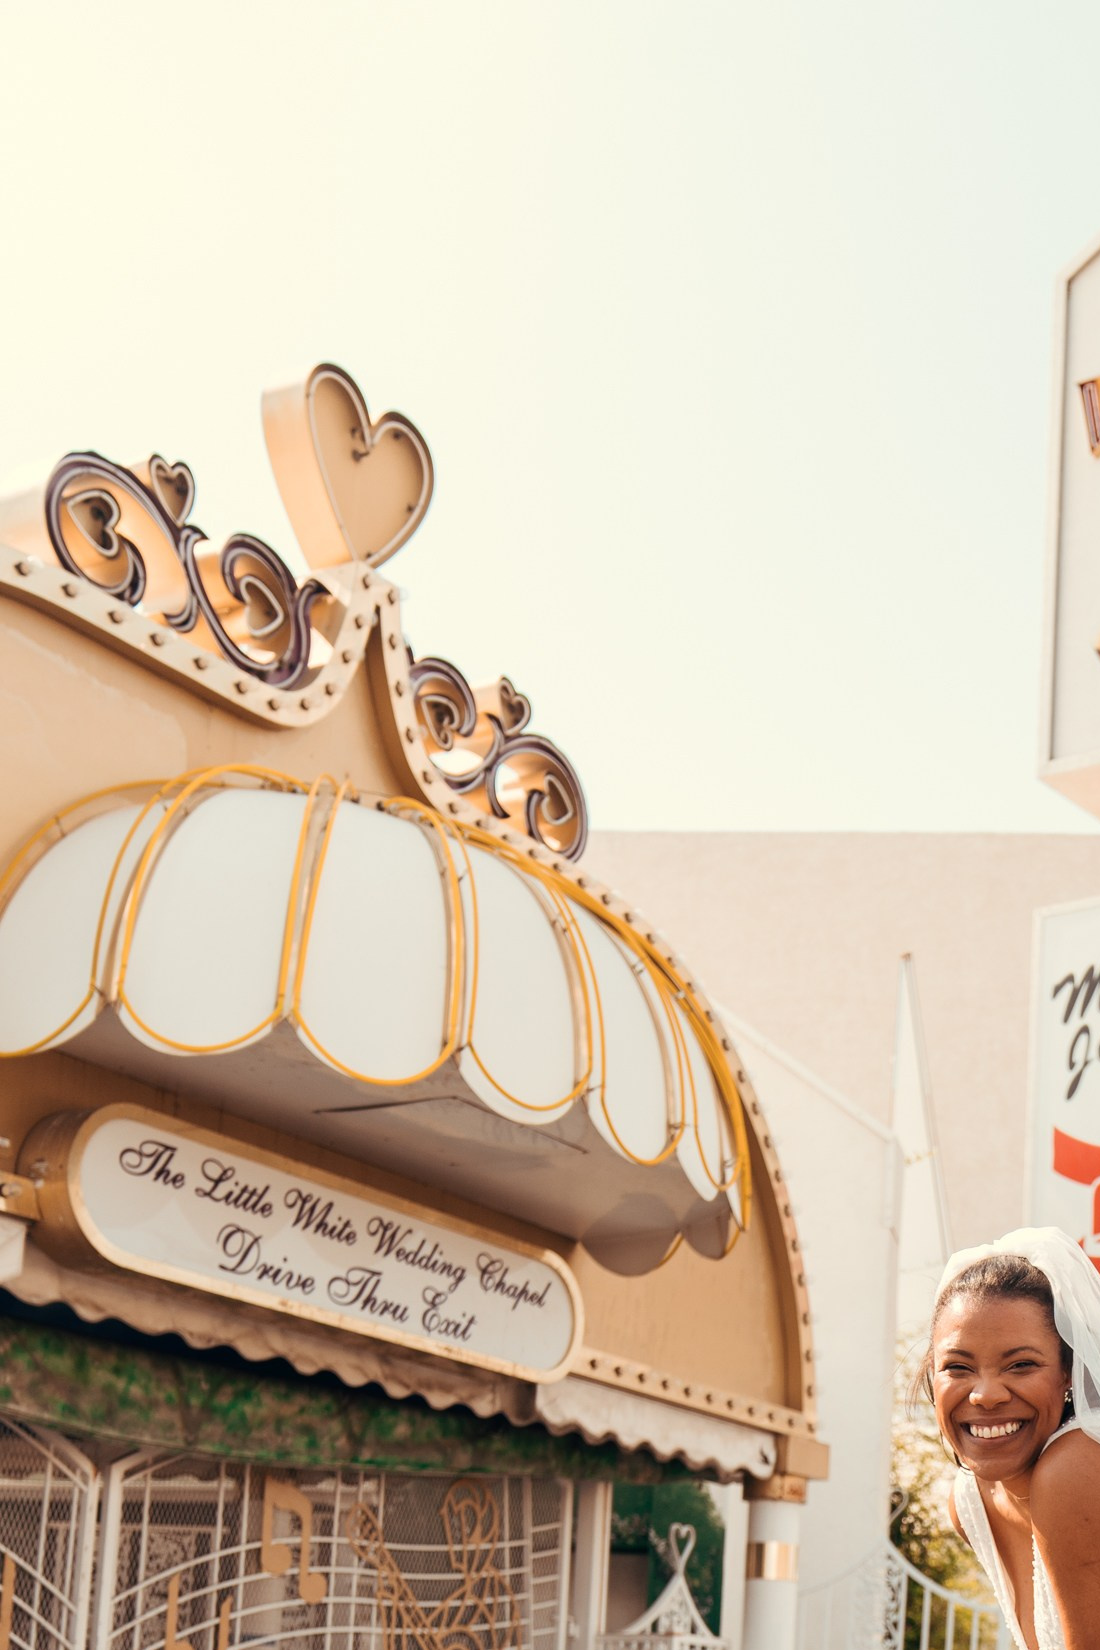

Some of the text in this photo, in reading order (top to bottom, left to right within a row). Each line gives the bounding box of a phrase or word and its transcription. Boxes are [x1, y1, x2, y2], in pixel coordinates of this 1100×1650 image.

[119, 1140, 552, 1308] The Little White Wedding Chapel
[216, 1223, 478, 1342] Drive Thru Exit
